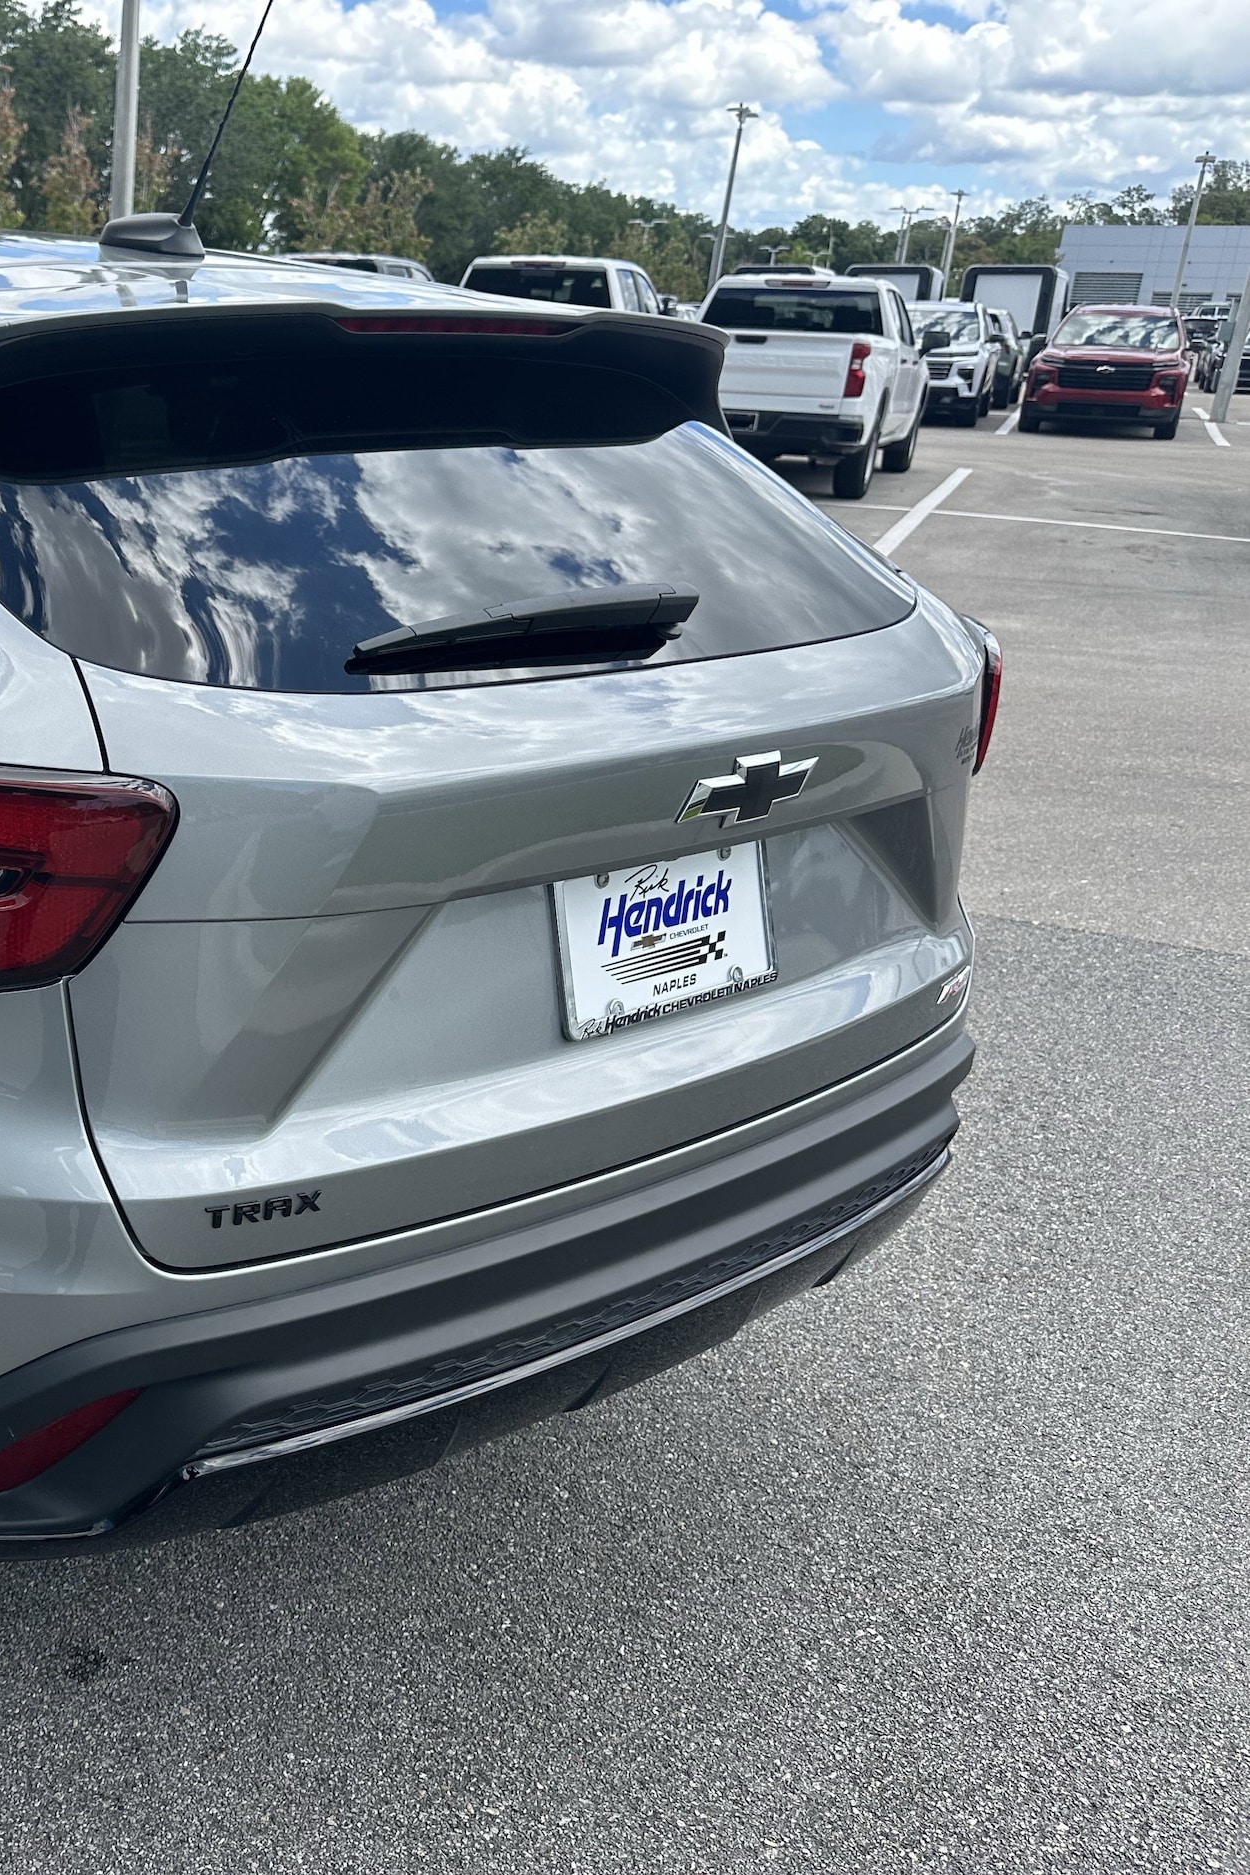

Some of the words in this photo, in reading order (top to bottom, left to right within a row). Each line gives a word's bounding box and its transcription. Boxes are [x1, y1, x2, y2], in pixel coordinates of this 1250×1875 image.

[597, 870, 732, 957] Hendrick
[669, 923, 709, 940] CHEVROLET
[605, 1003, 661, 1035] Hendrick
[662, 985, 730, 1014] CHEVROLET
[734, 972, 778, 993] NAPLES
[653, 973, 697, 996] NAPLES
[204, 1189, 323, 1229] TRAX
